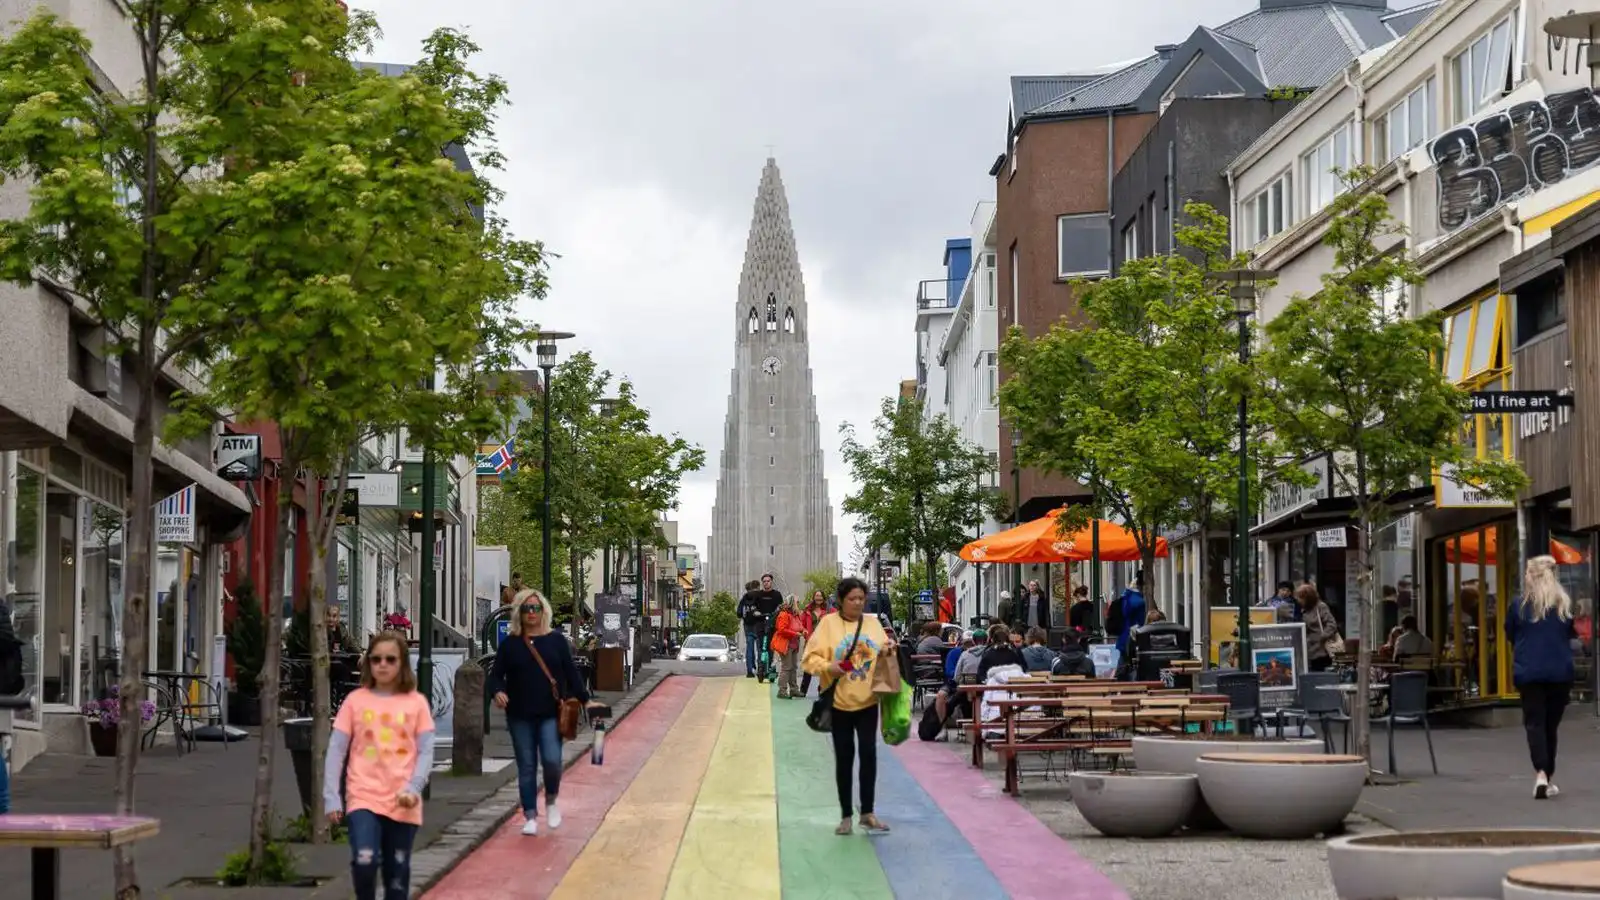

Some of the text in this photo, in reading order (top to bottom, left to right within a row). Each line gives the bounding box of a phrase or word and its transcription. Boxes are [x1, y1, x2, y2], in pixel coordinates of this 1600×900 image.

[1499, 395, 1527, 407] fine
[1530, 396, 1551, 407] art
[222, 438, 253, 450] ATM
[159, 517, 190, 526] TAX FREE
[159, 526, 190, 535] SHOPPING
